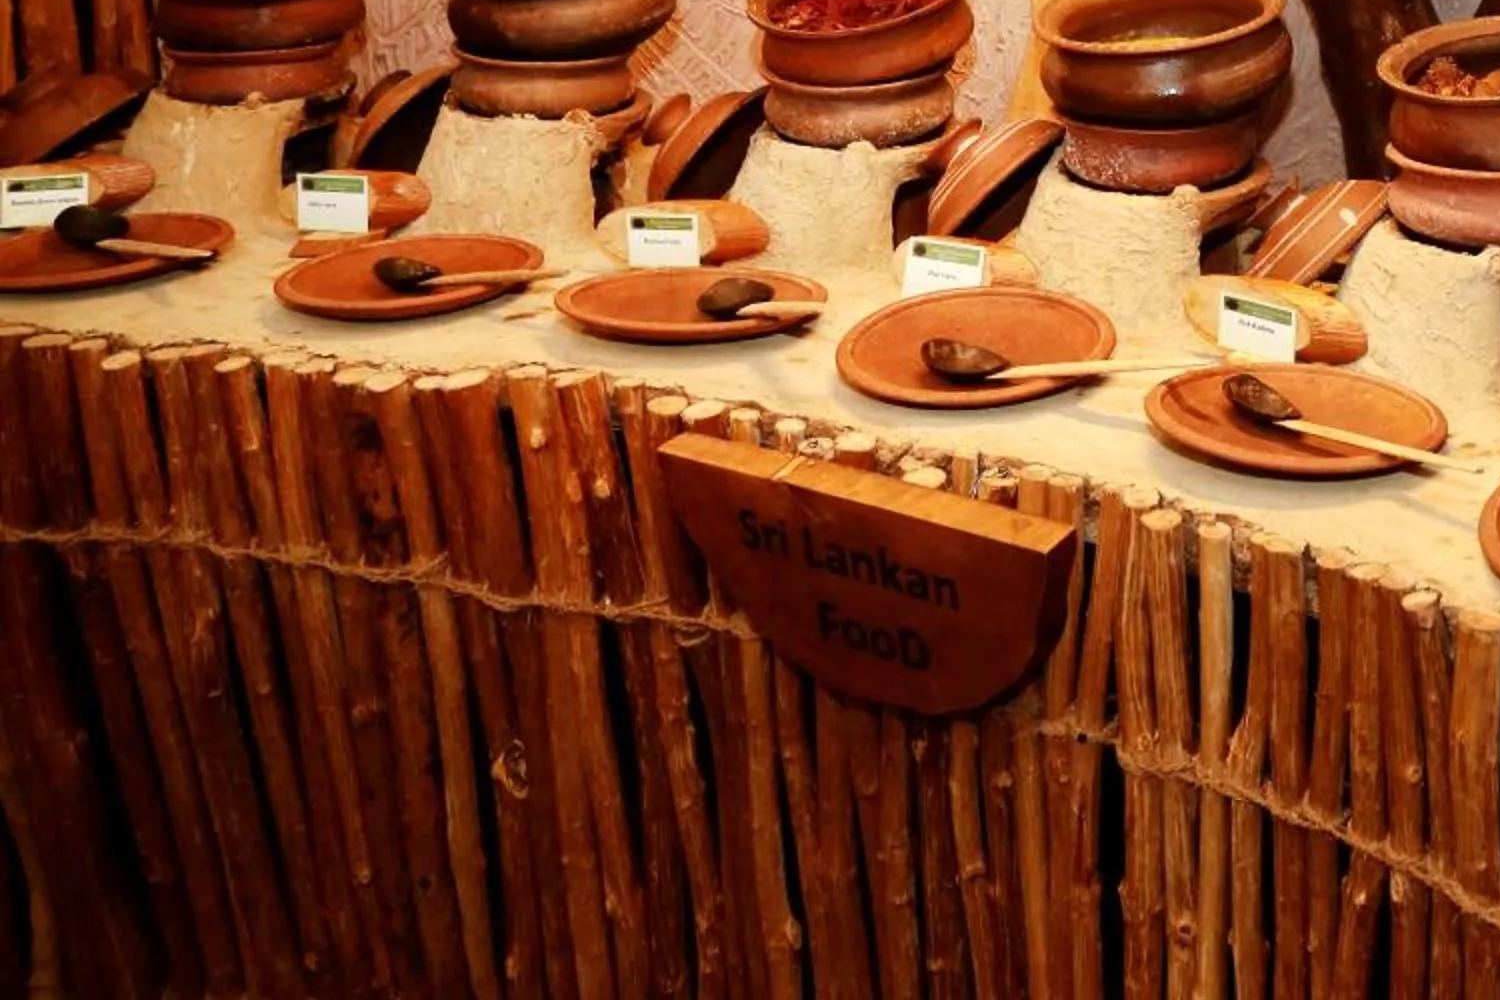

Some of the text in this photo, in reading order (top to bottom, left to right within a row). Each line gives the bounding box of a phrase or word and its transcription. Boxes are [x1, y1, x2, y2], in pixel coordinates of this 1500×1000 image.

[738, 509, 959, 611] Sri Lankan
[818, 601, 931, 671] FooD
